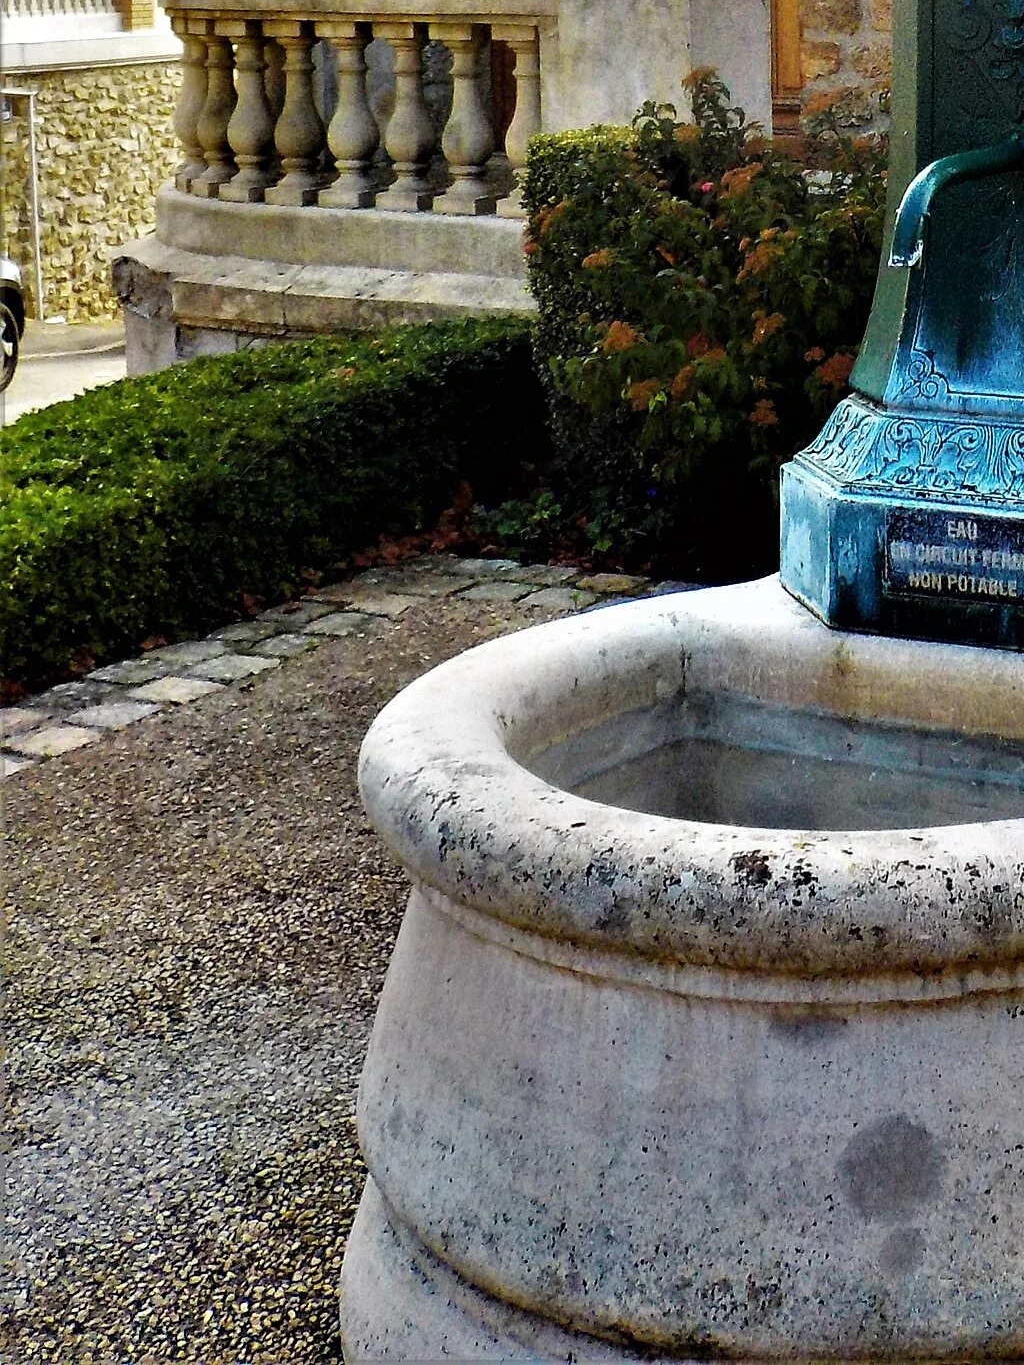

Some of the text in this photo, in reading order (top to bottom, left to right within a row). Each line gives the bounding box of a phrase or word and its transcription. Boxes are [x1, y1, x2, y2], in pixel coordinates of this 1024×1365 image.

[947, 519, 978, 541] EAU
[908, 572, 1017, 598] NON POTABLE
